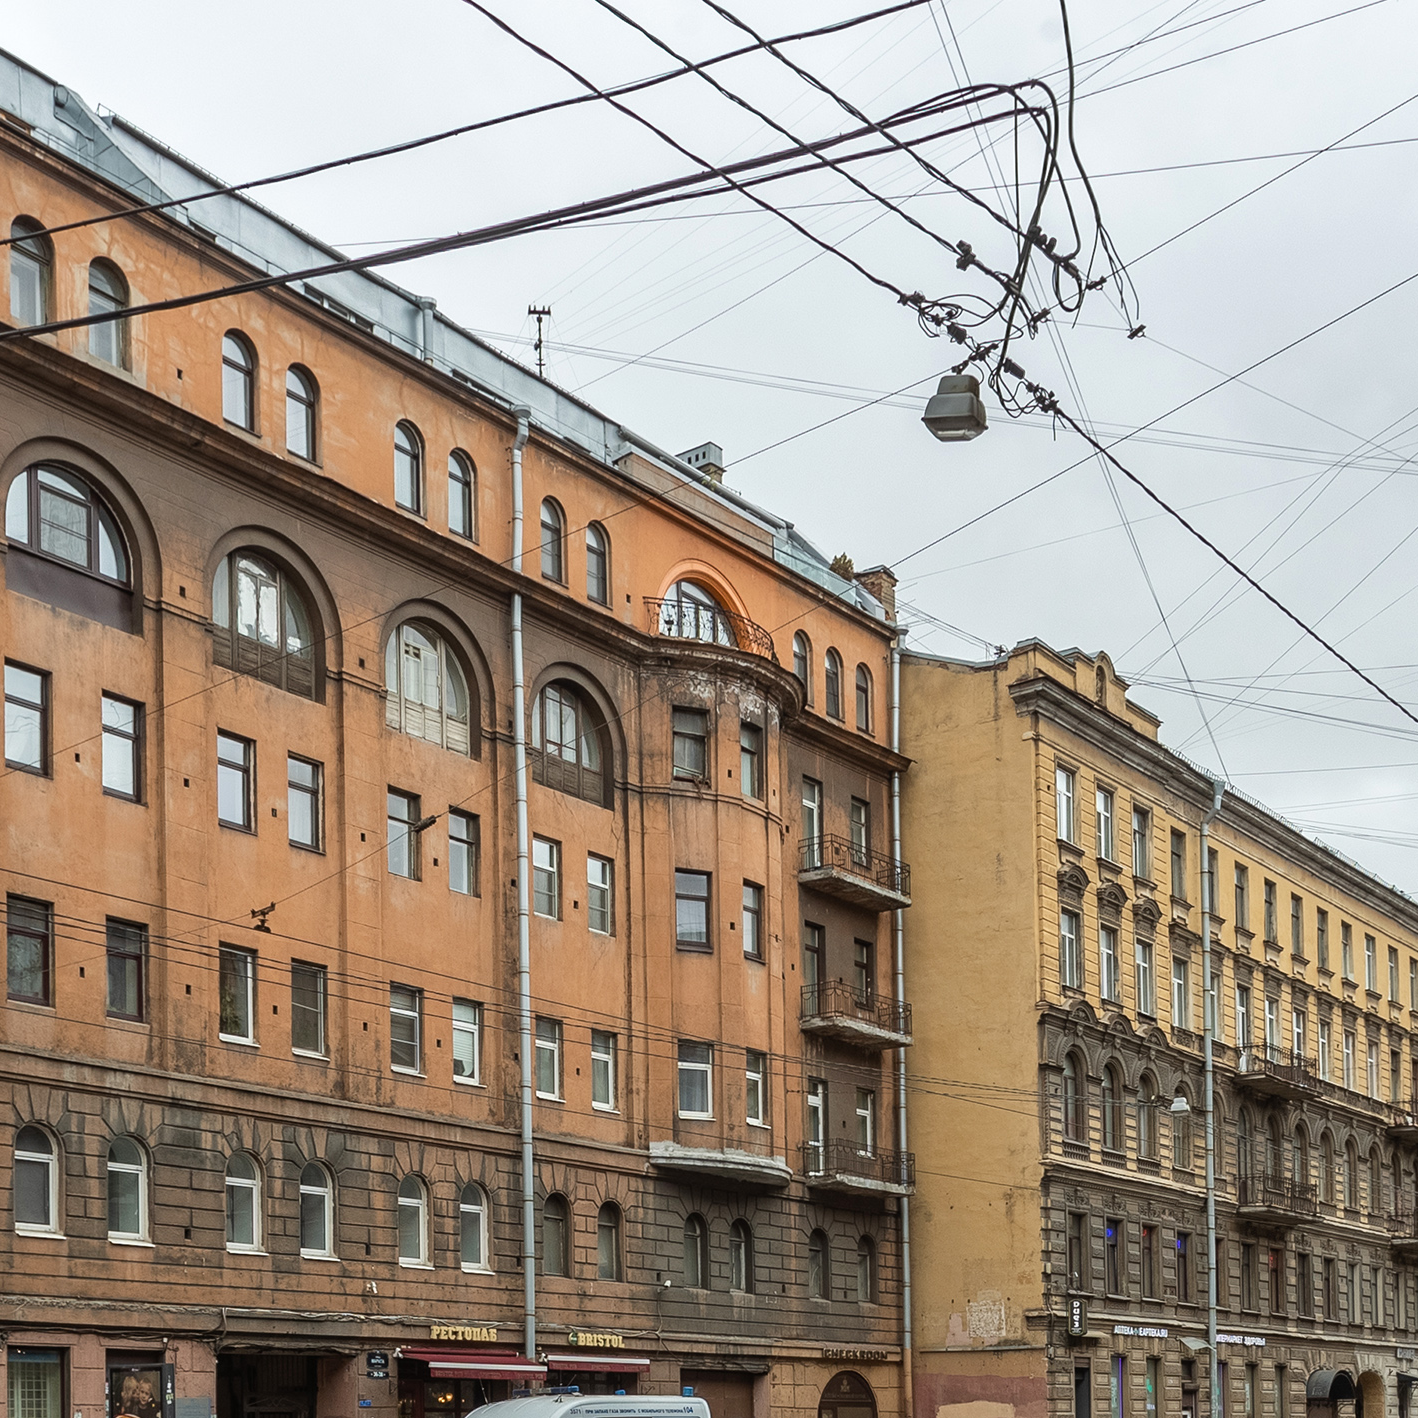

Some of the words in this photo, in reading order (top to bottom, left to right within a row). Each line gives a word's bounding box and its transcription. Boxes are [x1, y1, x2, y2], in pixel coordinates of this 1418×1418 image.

[430, 1326, 497, 1342] РЕСТОПАБ
[1113, 1325, 1134, 1336] АПТЕКА
[577, 1332, 625, 1348] BRISTOL
[824, 1348, 888, 1360] CHECKROOM
